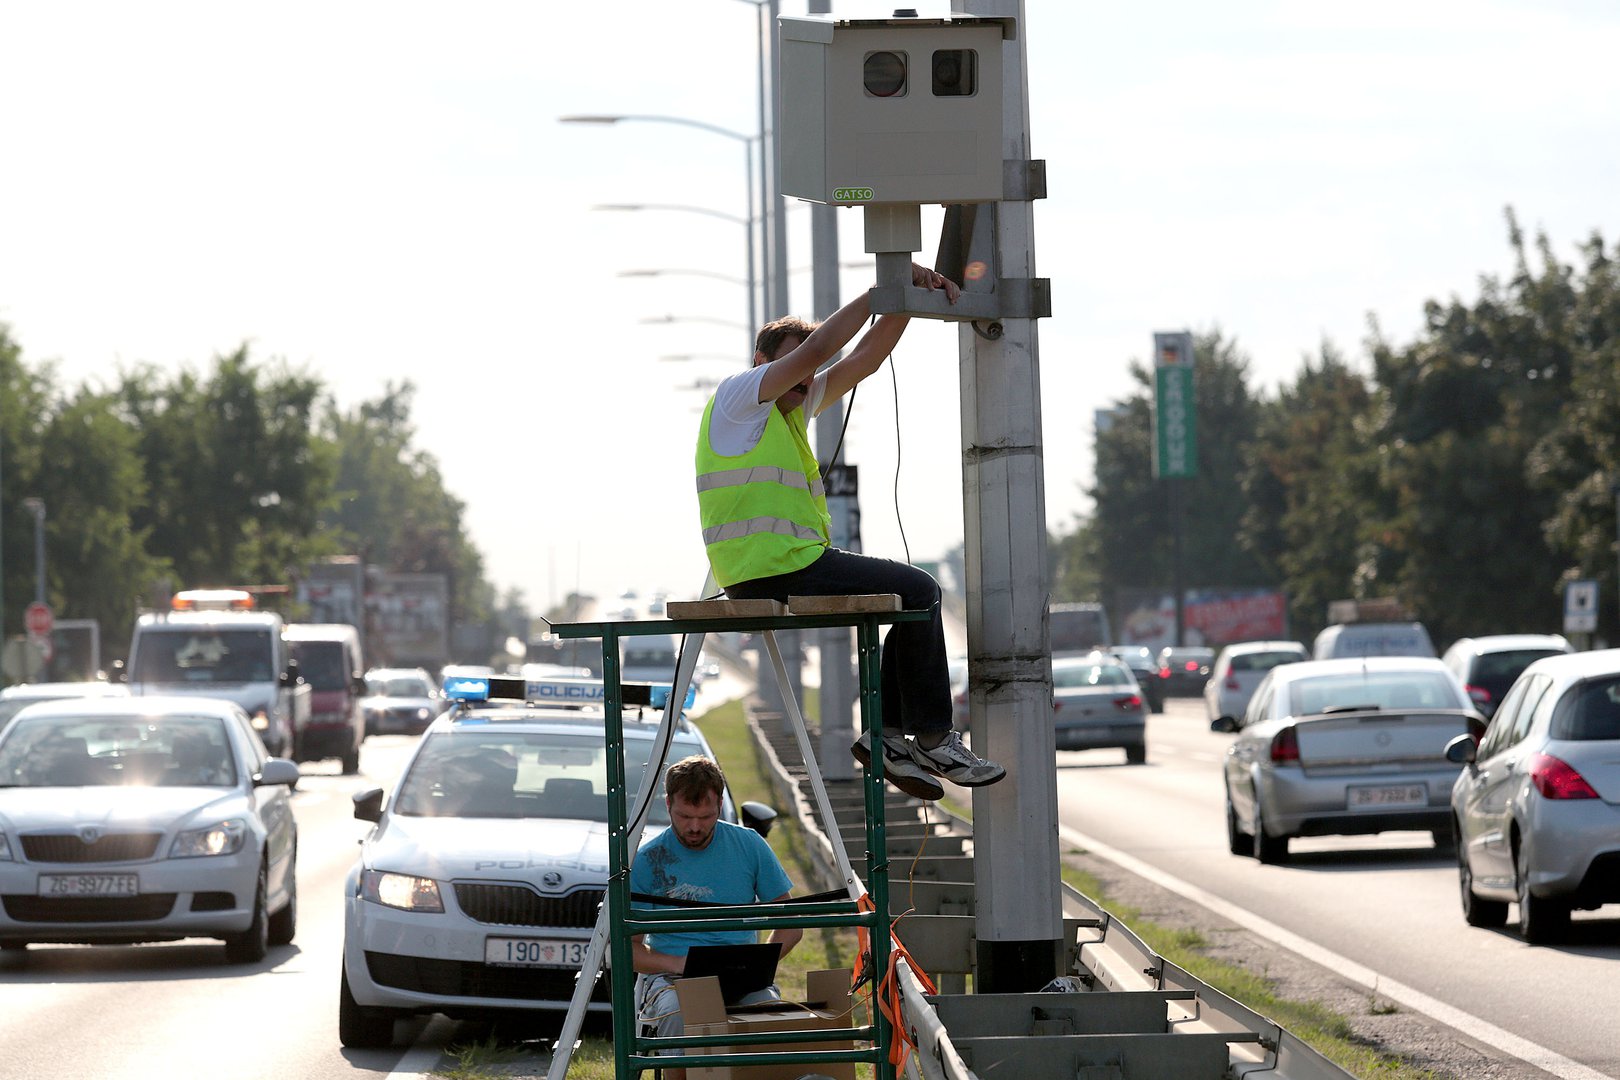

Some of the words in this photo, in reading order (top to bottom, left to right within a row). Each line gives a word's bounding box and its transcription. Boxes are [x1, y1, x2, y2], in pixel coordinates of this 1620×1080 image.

[834, 190, 873, 199] GATSO
[474, 859, 608, 873] POLICIJ
[507, 941, 540, 962] 190
